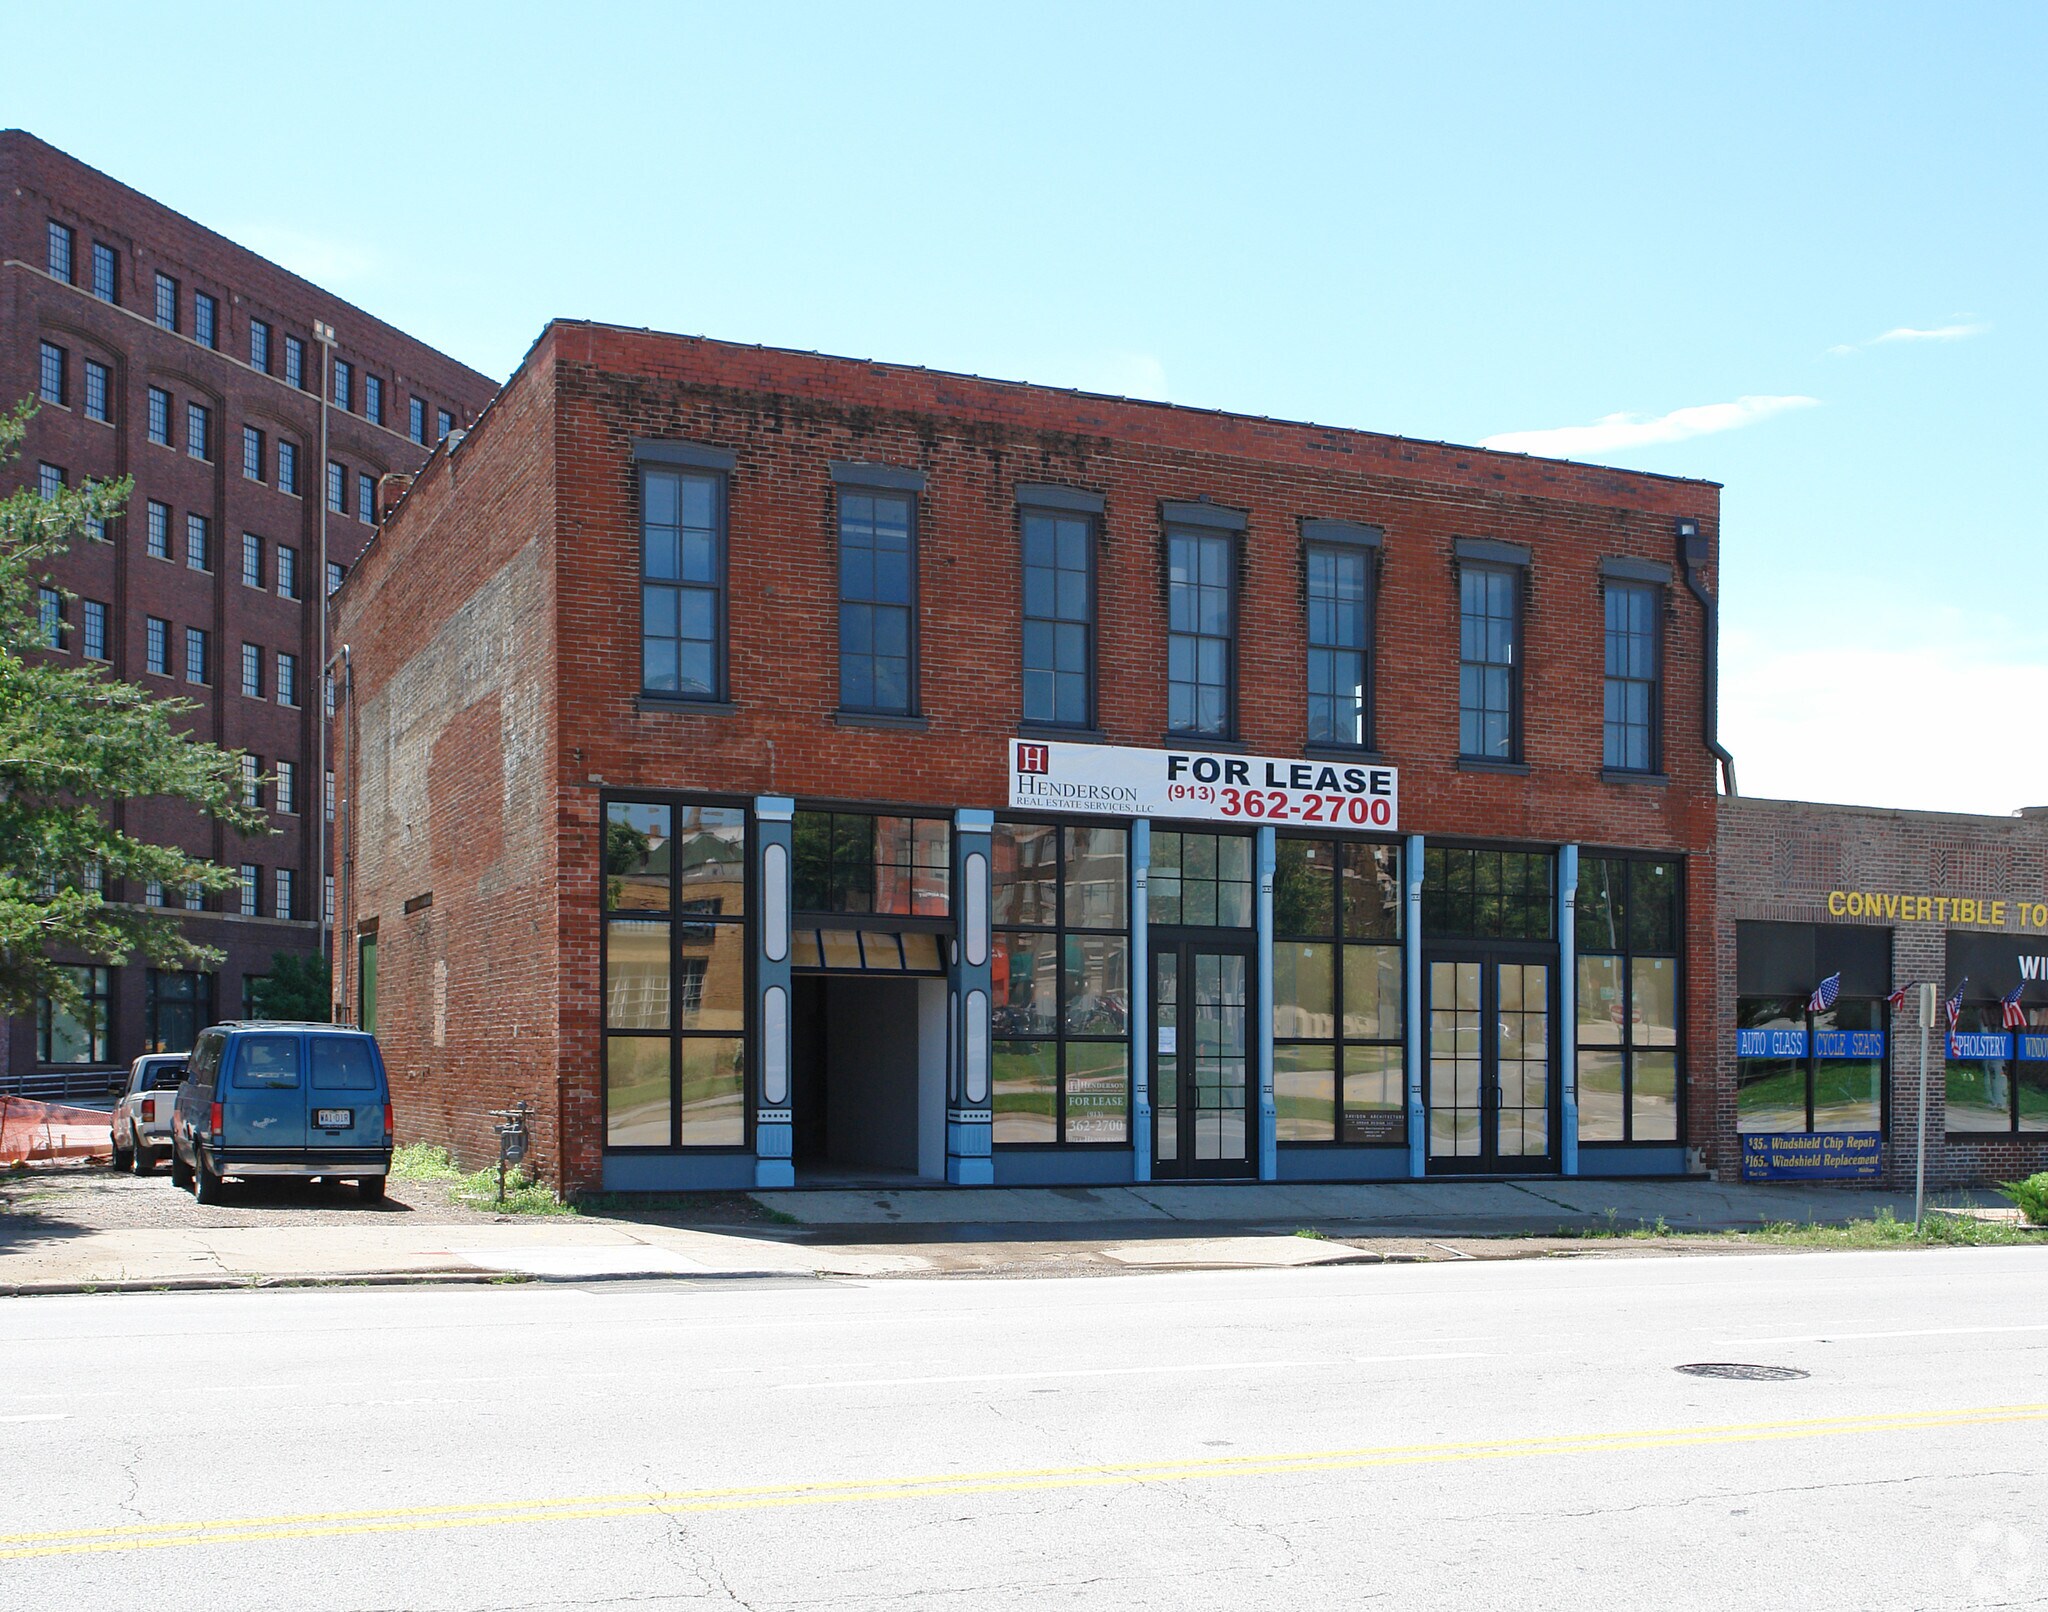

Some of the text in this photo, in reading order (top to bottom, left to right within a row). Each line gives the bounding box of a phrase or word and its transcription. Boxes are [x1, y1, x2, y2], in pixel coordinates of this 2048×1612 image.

[1022, 746, 1044, 772] H
[1017, 774, 1137, 801] HENDERSON
[1167, 755, 1392, 796] FOR LEASE
[1016, 796, 1154, 813] REAL ESTATE SERVICES, LLC
[1167, 784, 1392, 826] (913) 362-2700
[1828, 890, 2005, 926] CONVERTIBLE
[2018, 955, 2048, 981] WI
[1741, 1031, 1803, 1056] AUTO GLASS
[1816, 1033, 1881, 1056] CYCLE SEATS
[1080, 1081, 1124, 1089] HENDERSON
[1069, 1096, 1124, 1106] FOR LEASE
[1069, 1120, 1123, 1132] 362-2700
[1771, 1136, 1820, 1150] Windshield
[1823, 1136, 1844, 1150] Chip
[1847, 1136, 1876, 1150] Repair
[1772, 1154, 1821, 1168] Windshield
[1824, 1154, 1879, 1168] Replacement
